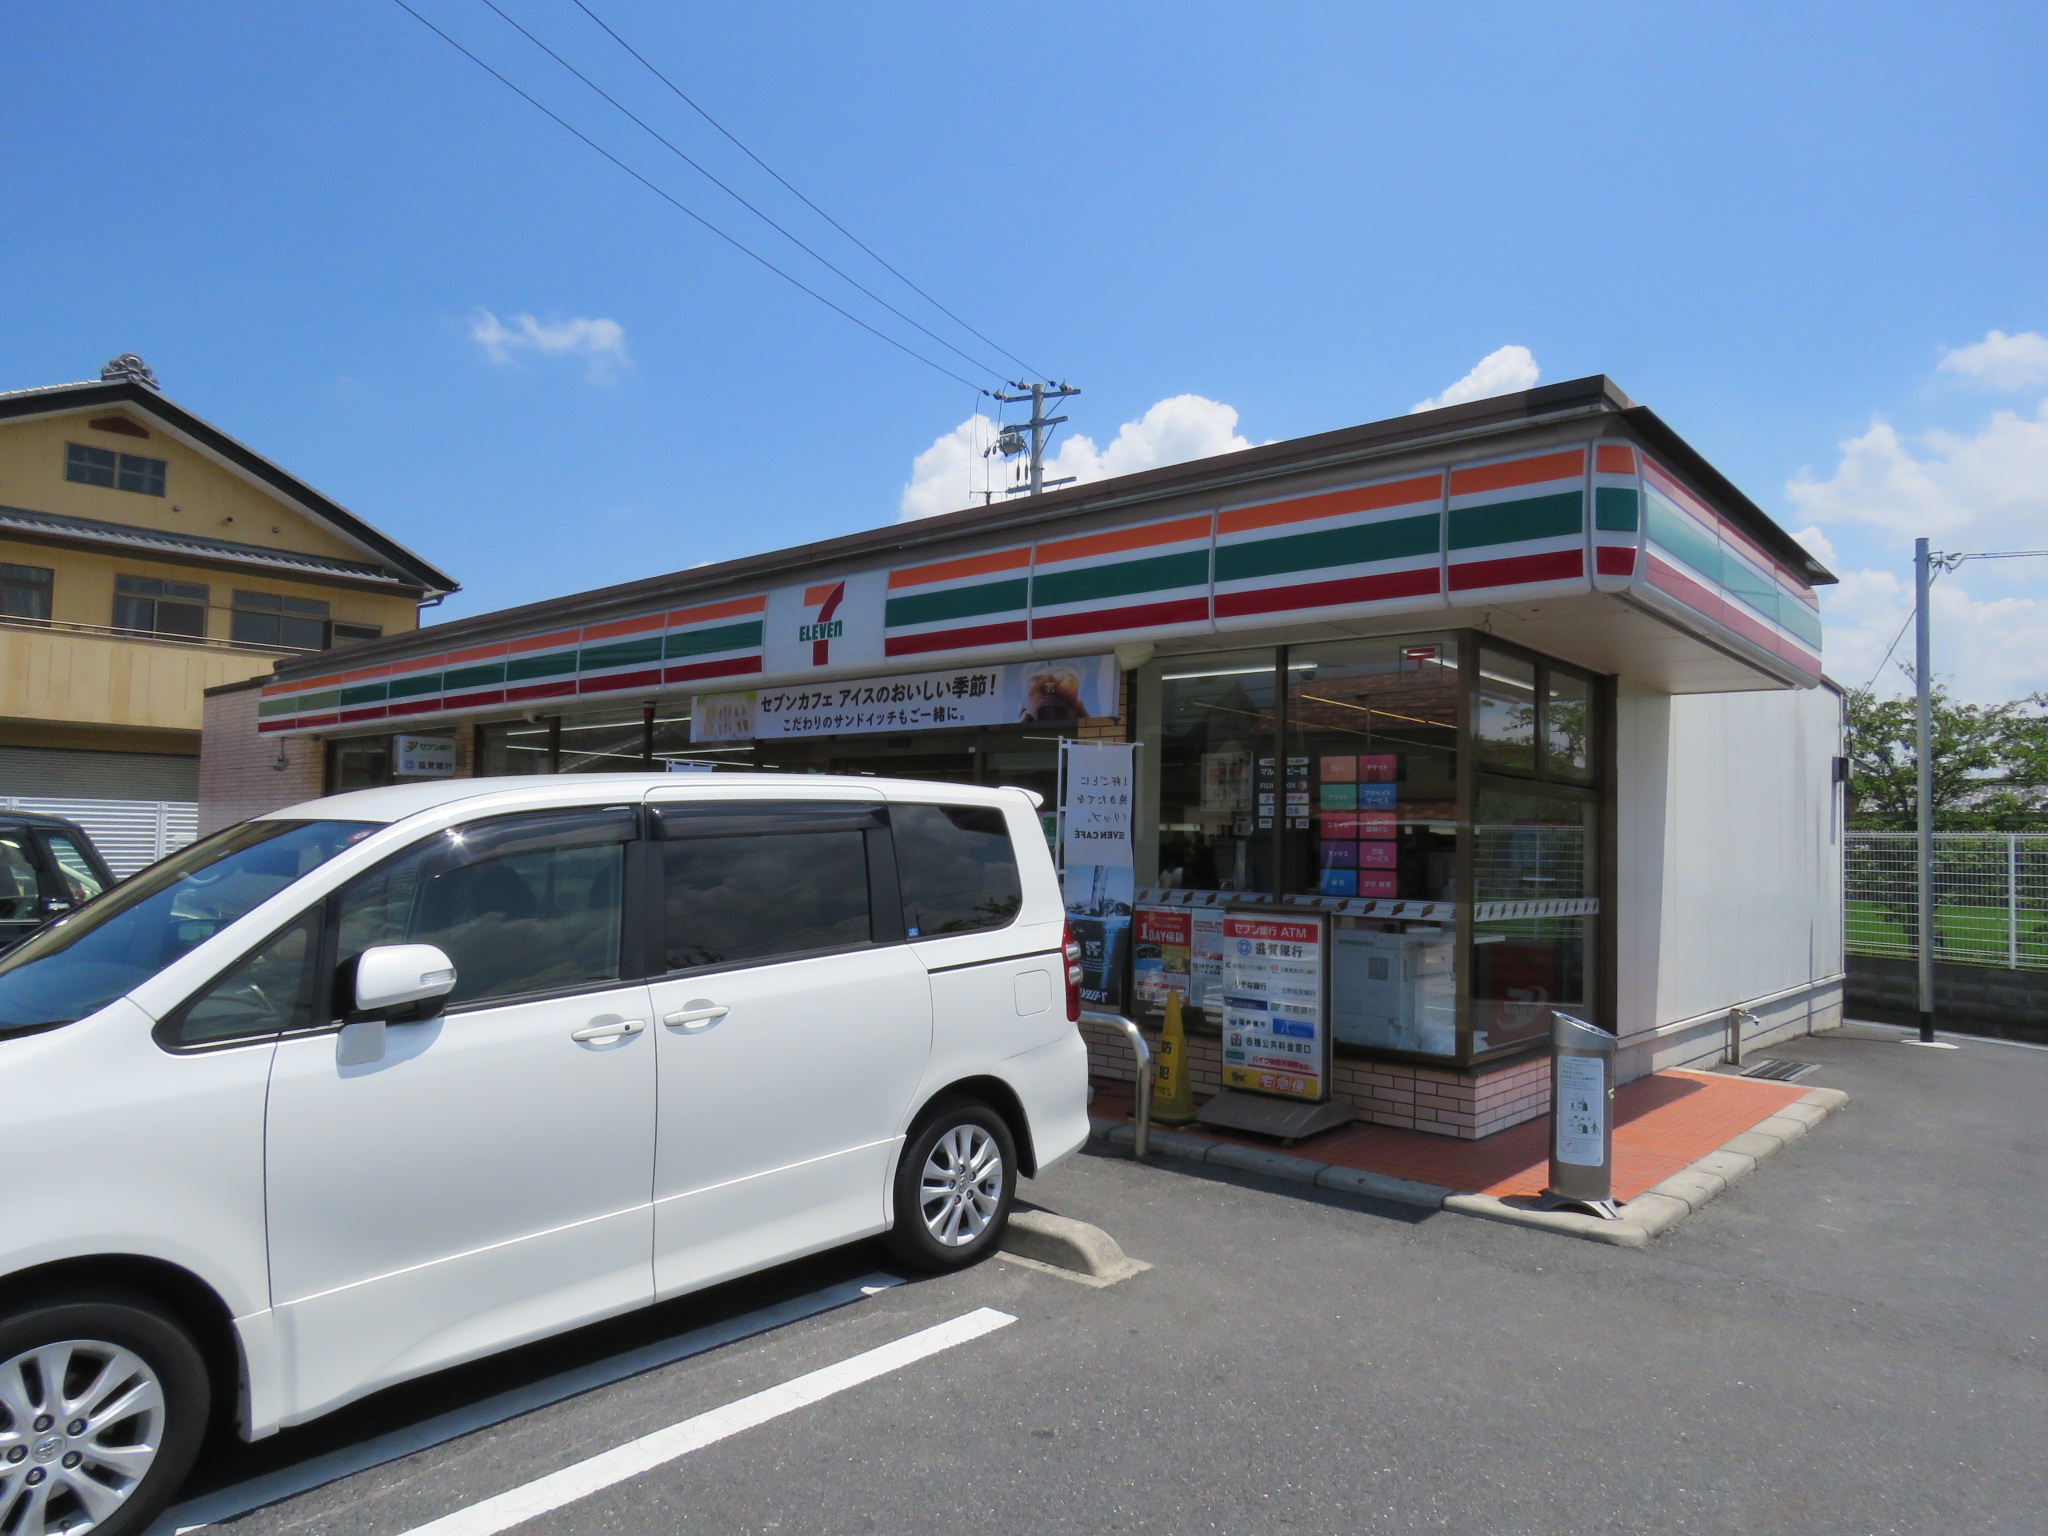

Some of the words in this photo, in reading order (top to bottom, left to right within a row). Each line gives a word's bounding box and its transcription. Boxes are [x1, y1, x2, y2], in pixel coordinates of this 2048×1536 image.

[761, 692, 833, 714] セブンカフェ
[839, 674, 996, 708] アイスのおいしい季節!
[783, 705, 965, 733] こだわりのサンドイッチもご一緒に。
[1234, 923, 1277, 937] セブン銀行
[1281, 927, 1306, 938] ATM
[1255, 942, 1303, 958] 滋賀銀行
[1246, 1037, 1311, 1054] 各種公共料金窓口
[1261, 1074, 1305, 1094] 宅急便
